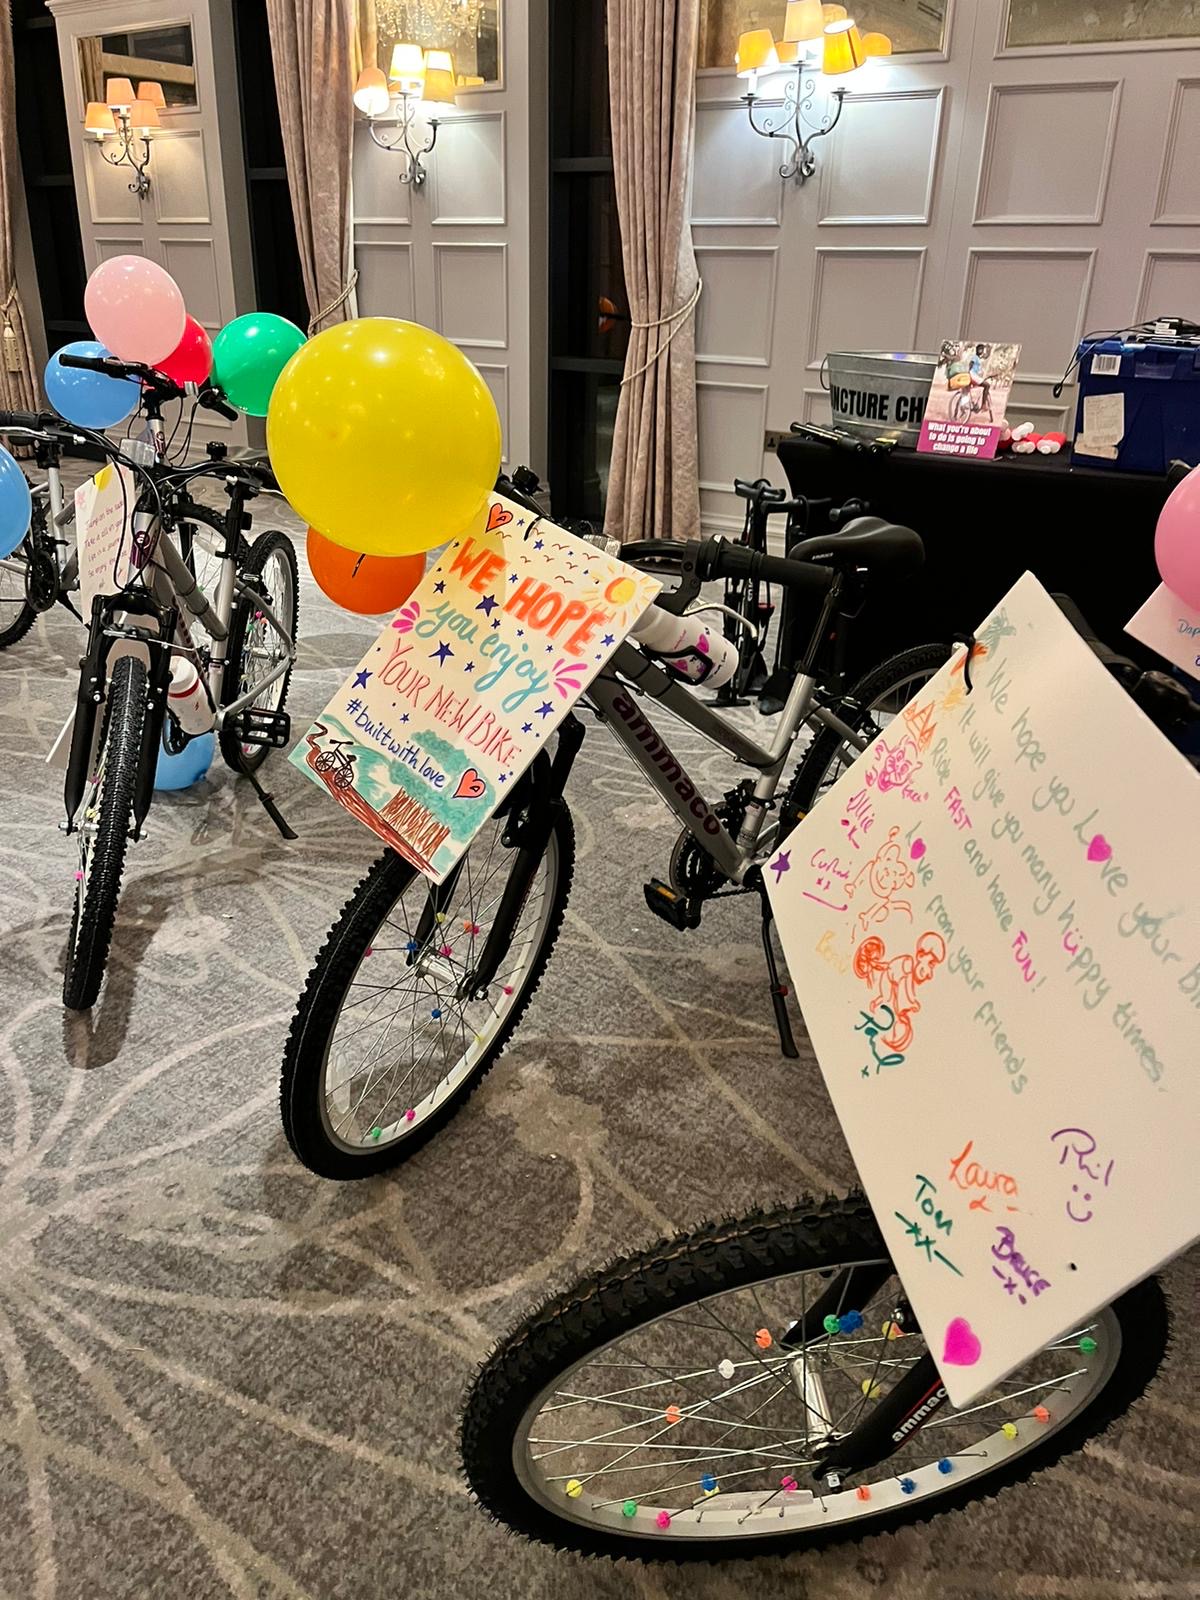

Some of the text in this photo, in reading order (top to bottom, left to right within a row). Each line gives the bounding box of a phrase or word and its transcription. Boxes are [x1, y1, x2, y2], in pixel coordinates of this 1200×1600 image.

[928, 422, 946, 432] What
[970, 427, 992, 437] about
[929, 432, 937, 441] to
[937, 433, 947, 441] do
[956, 435, 976, 445] going
[977, 436, 986, 445] to
[933, 443, 960, 453] change
[448, 537, 611, 657] WE HOPE
[415, 600, 550, 713] you enjoy
[378, 637, 522, 768] YOUR NEW BIKE
[612, 692, 720, 835] ammaco
[969, 730, 991, 768] will
[986, 657, 1012, 714] We
[1011, 706, 1046, 772] hope
[1032, 775, 1076, 816] you
[972, 767, 1005, 809] give
[931, 737, 951, 787] Ride
[944, 786, 972, 830] FAST
[964, 838, 992, 877] and
[987, 873, 1013, 932] have
[991, 811, 1024, 844] you
[1021, 844, 1061, 916] many
[925, 894, 954, 943] from
[947, 946, 984, 992] your
[974, 1000, 1028, 1095] friends
[949, 1140, 1018, 1196] Laura
[1051, 1128, 1114, 1188] Phil
[915, 1174, 953, 1236] Tom
[892, 1387, 947, 1442] ammac
